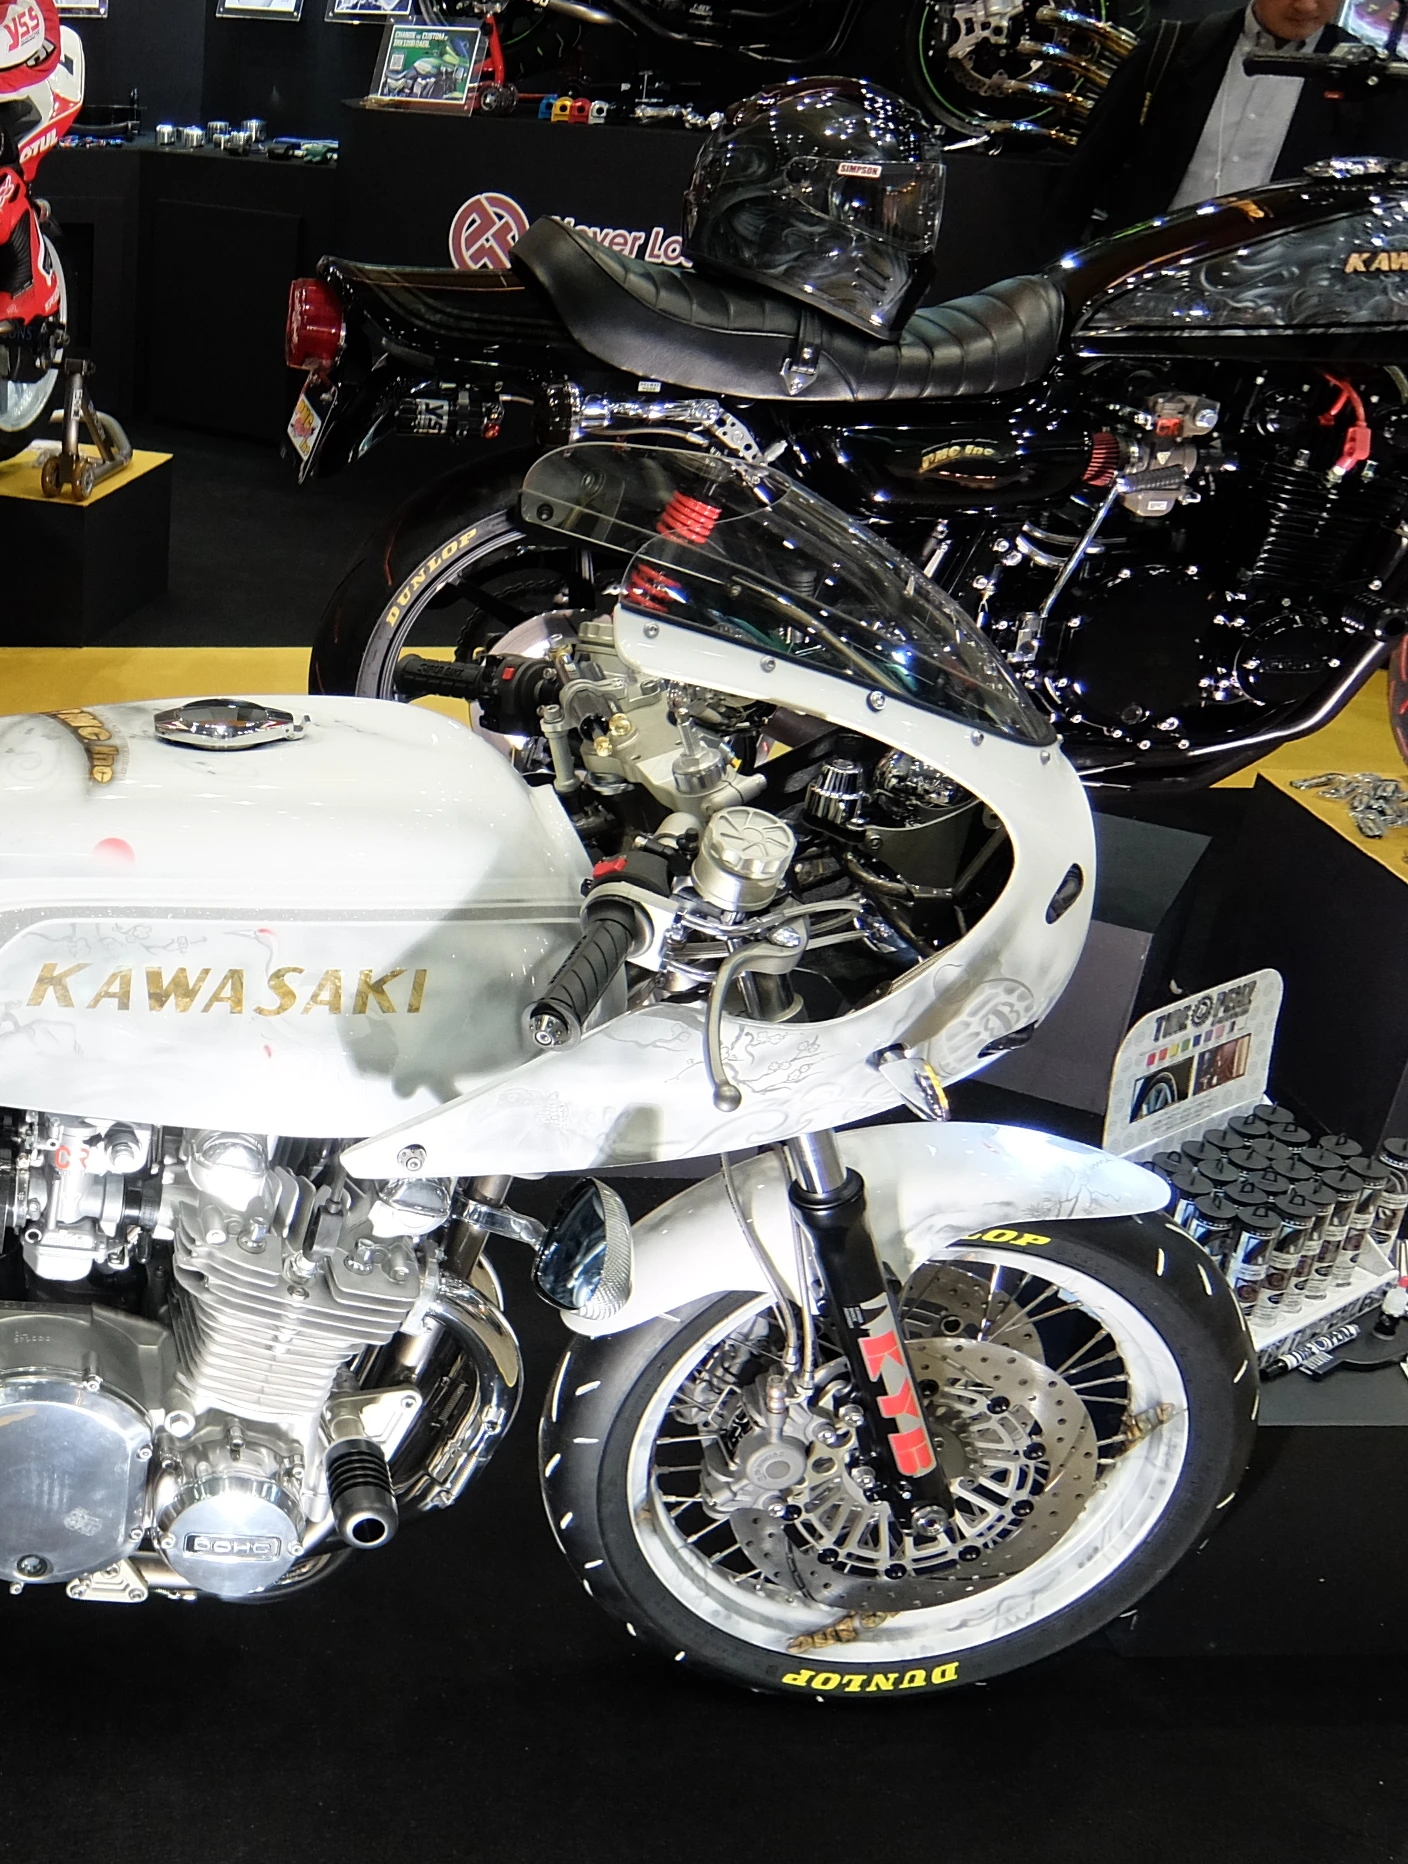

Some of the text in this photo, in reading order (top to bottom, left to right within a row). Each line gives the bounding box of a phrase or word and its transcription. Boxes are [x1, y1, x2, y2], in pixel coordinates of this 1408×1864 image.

[4, 6, 40, 52] YSS
[18, 127, 59, 164] OTUL
[840, 164, 879, 175] SIMPSON
[645, 225, 694, 267] Lo
[384, 528, 479, 628] DUNLOP
[25, 961, 429, 1018] KAWASAKI
[857, 1329, 937, 1478] KYB
[193, 1537, 273, 1555] DOHC
[781, 1661, 960, 1692] DUNLOP
